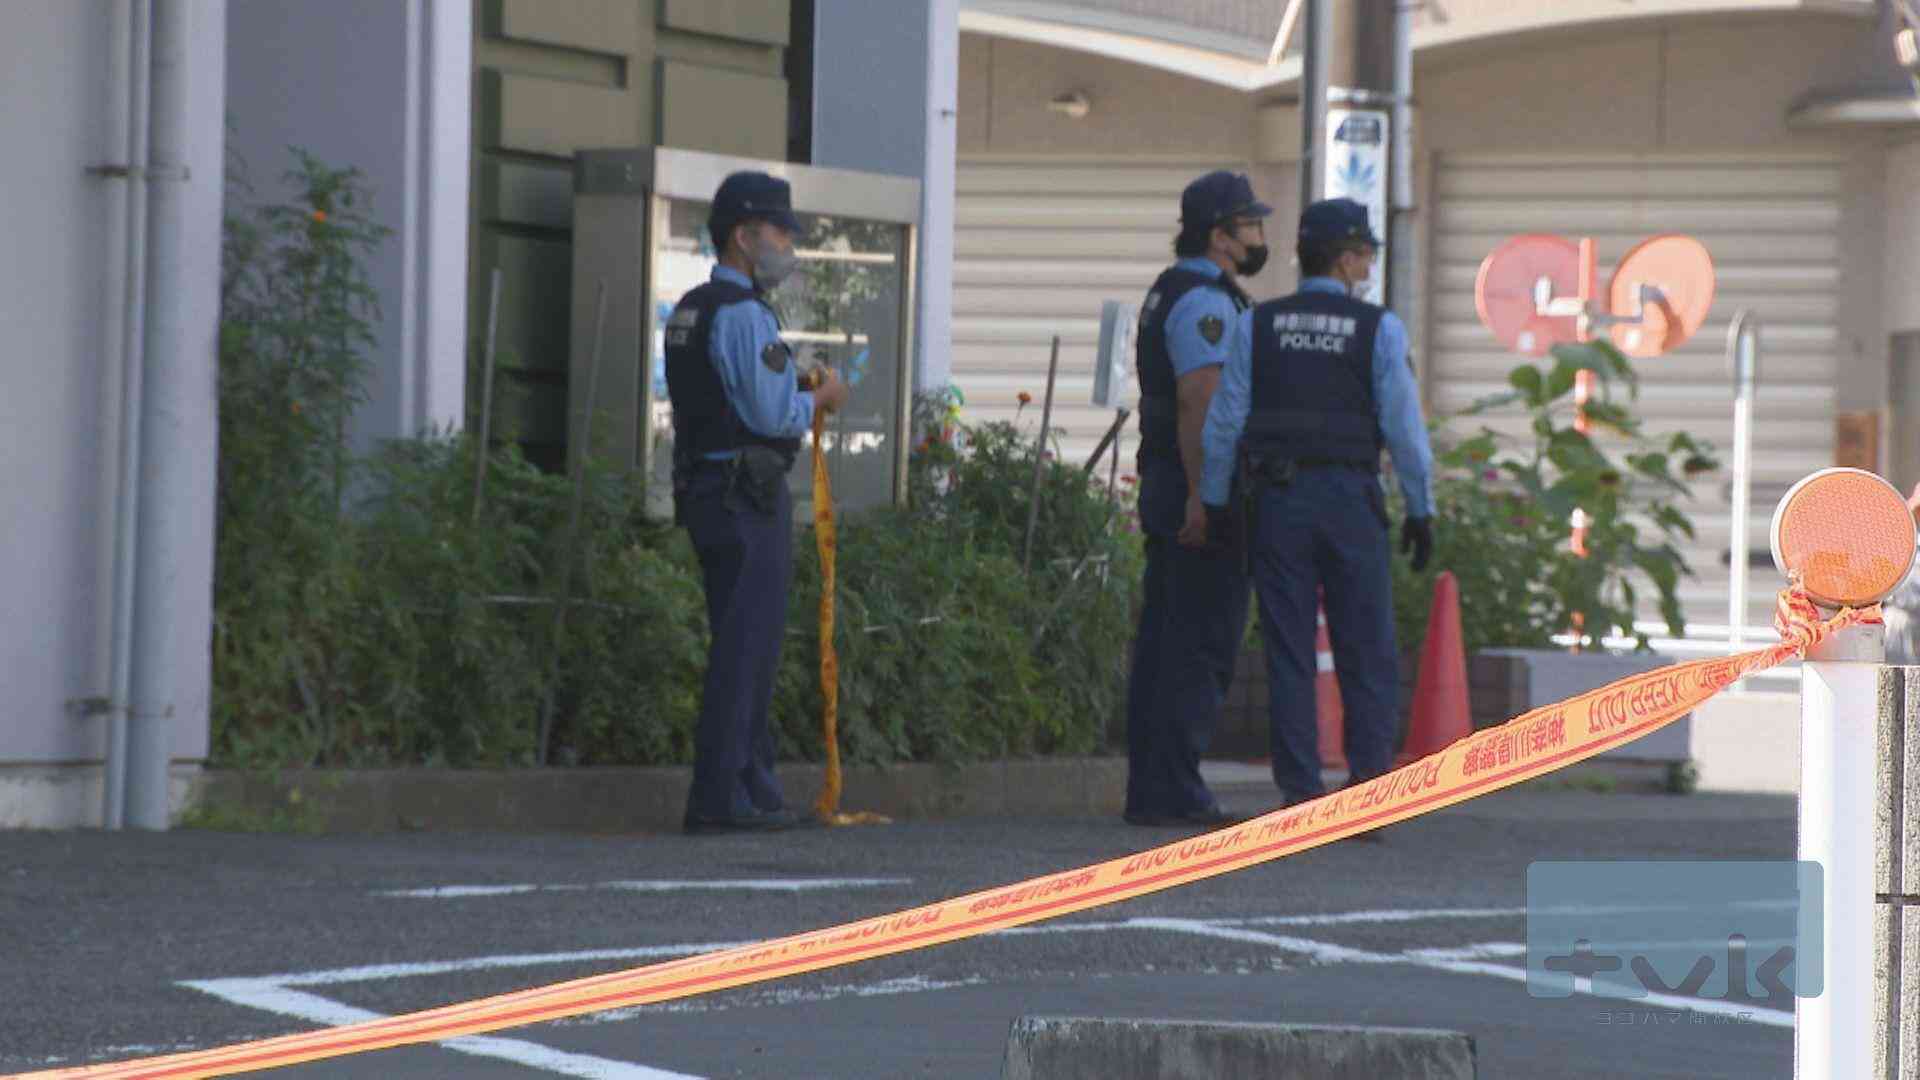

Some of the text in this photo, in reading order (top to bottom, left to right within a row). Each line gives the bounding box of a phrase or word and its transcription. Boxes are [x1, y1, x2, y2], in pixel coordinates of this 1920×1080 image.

[1280, 333, 1346, 353] POLICE
[1588, 690, 1630, 735] OUT
[1631, 672, 1688, 717] KEEP
[1359, 757, 1445, 809] POLICE
